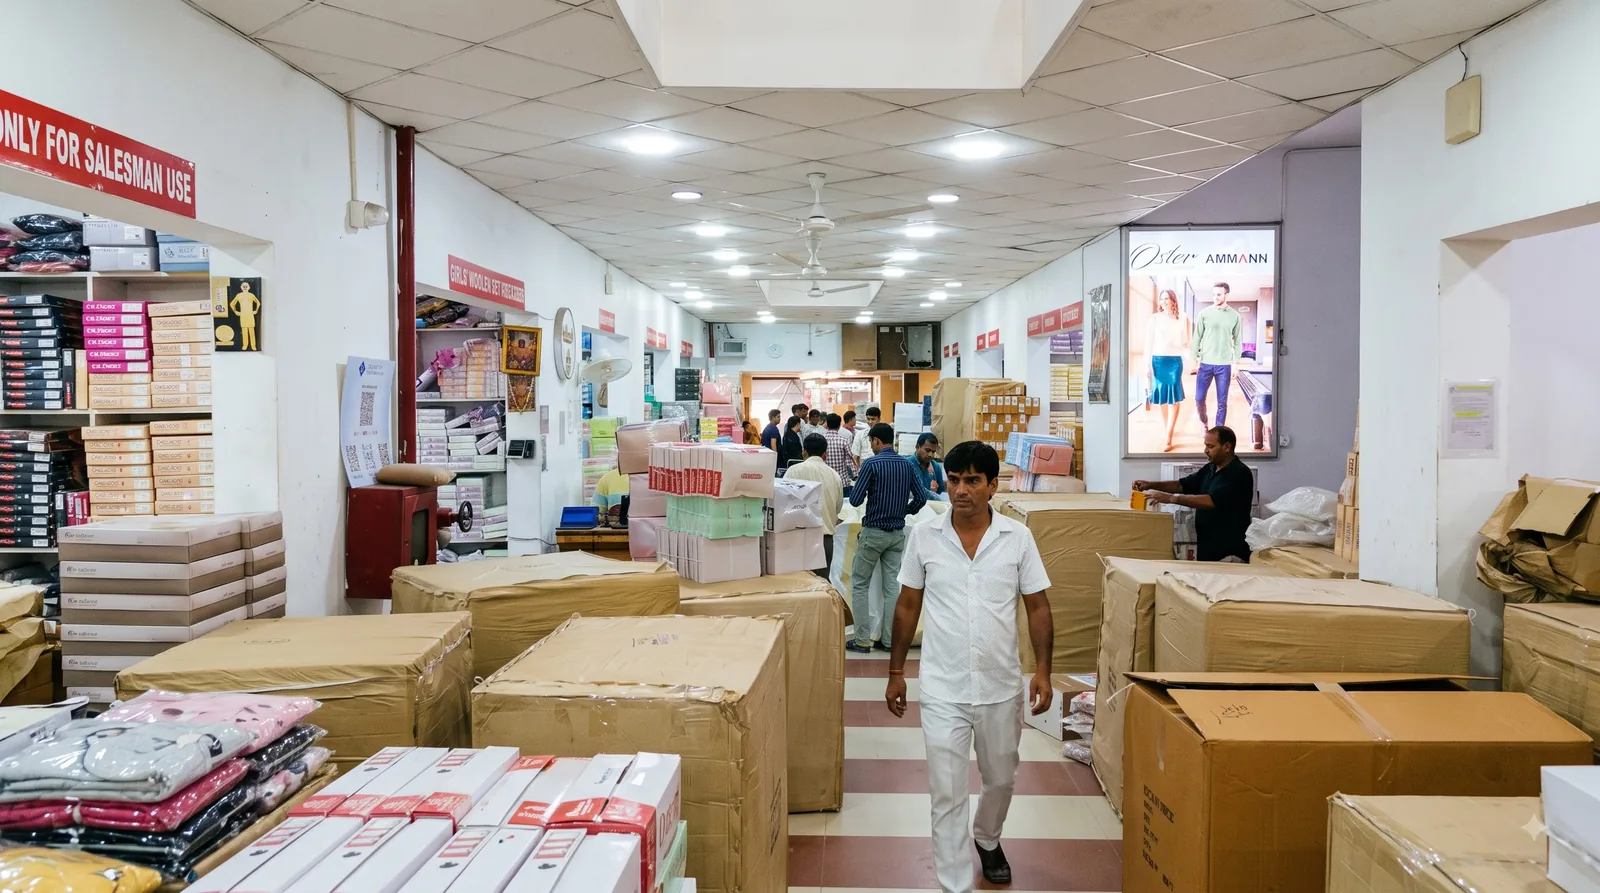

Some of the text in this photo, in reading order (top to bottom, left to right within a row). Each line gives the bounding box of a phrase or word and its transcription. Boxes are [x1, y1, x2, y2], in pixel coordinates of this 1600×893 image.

[45, 124, 80, 169] FOR
[84, 138, 163, 195] SALESMAN
[167, 169, 192, 205] USE
[1205, 253, 1268, 264] AMMANN
[469, 270, 491, 293] WOOLEN
